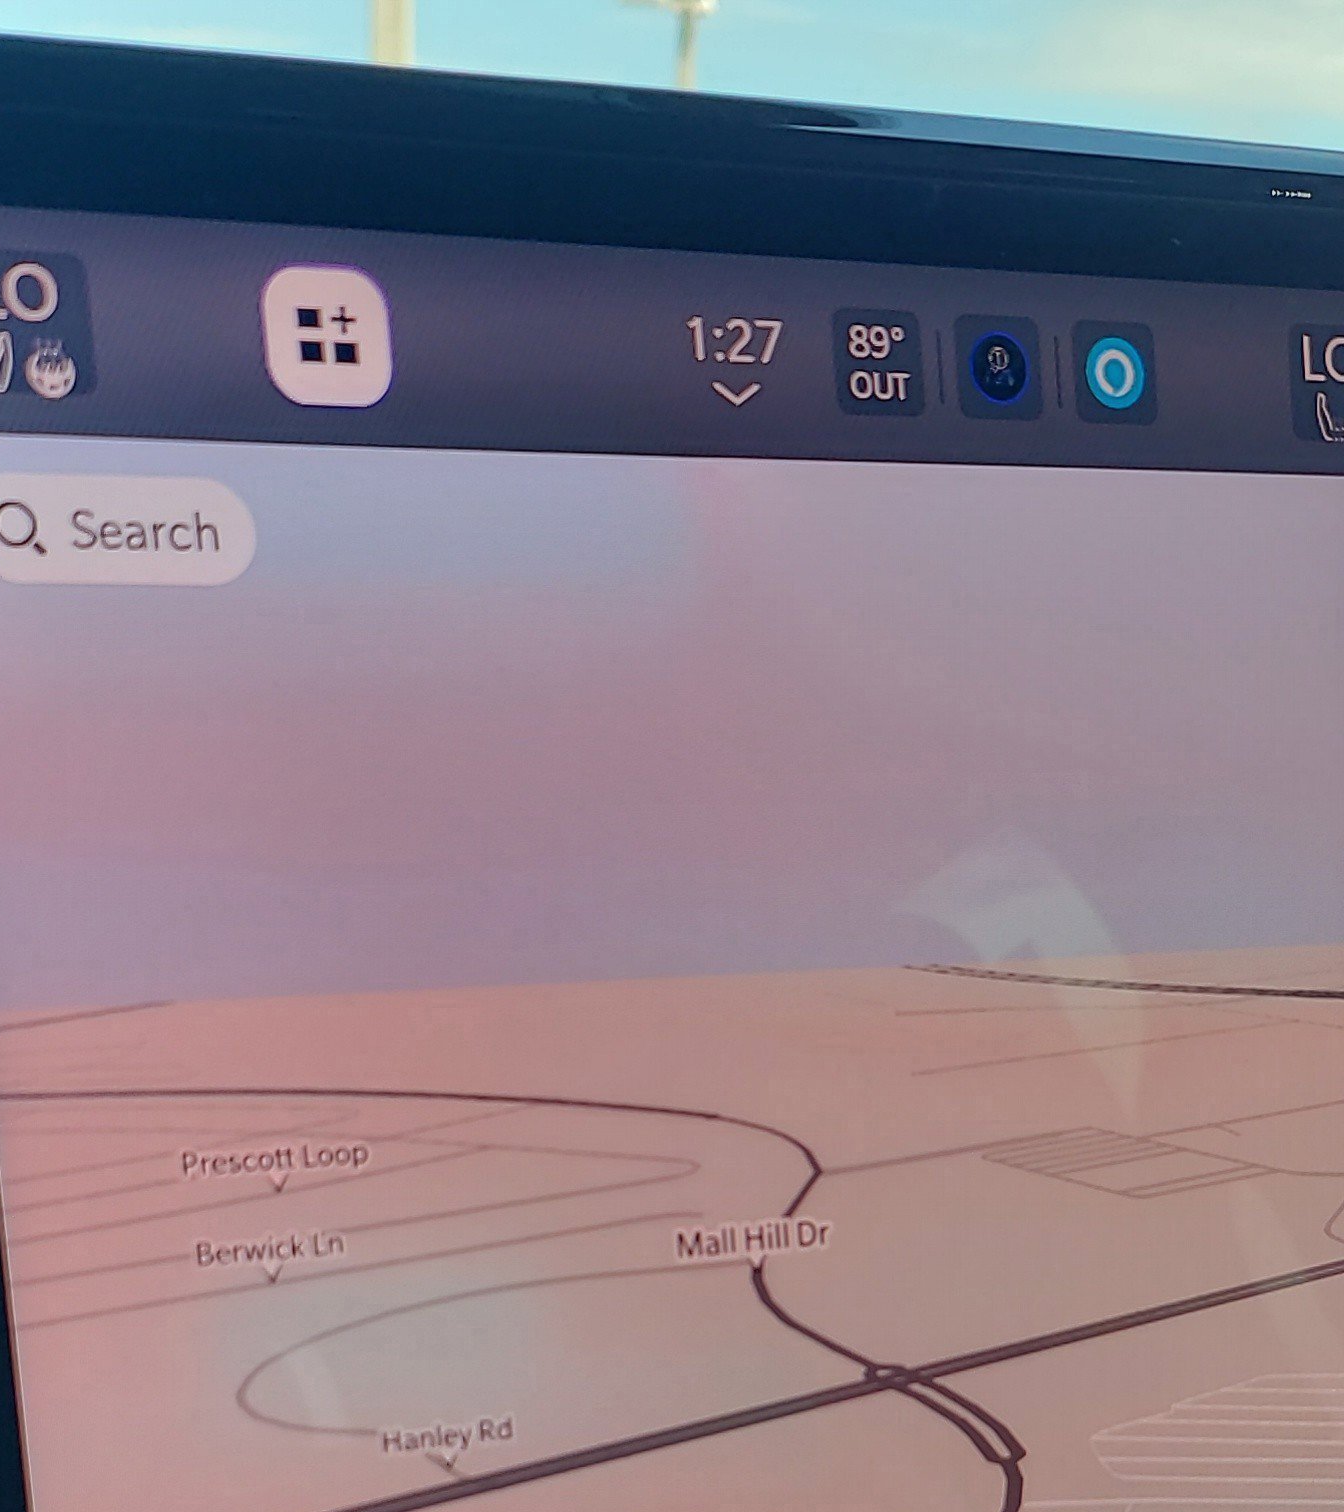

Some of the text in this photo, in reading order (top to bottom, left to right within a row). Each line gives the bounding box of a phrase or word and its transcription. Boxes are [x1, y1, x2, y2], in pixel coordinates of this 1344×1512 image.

[686, 315, 784, 365] 1:27
[849, 369, 911, 402] OUT
[71, 509, 221, 554] Search
[181, 1141, 370, 1178] Prescott Loop
[195, 1231, 346, 1266] Berwick Ln
[676, 1220, 831, 1258] Mall Hill Dr
[381, 1417, 514, 1455] Hanley Rd
